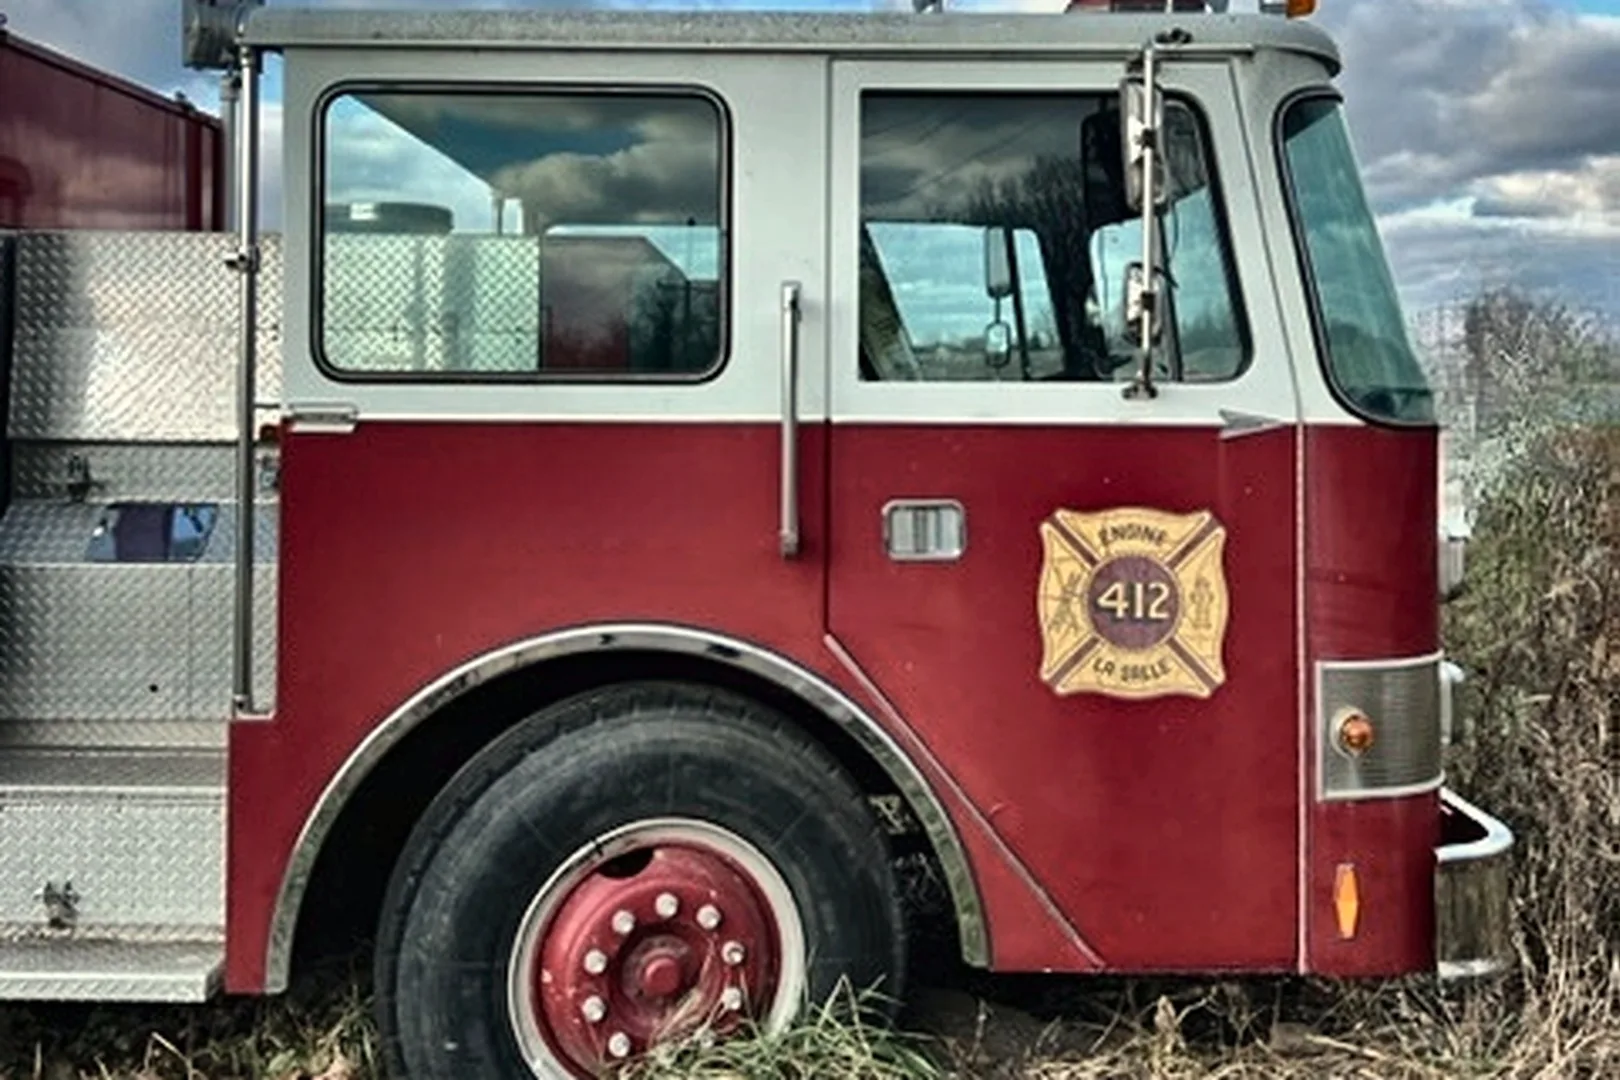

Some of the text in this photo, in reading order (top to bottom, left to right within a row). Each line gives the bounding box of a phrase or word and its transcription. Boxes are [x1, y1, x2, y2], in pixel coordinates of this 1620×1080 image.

[1098, 523, 1168, 546] ENGINE
[1096, 581, 1170, 619] 412
[1093, 658, 1115, 676] LA
